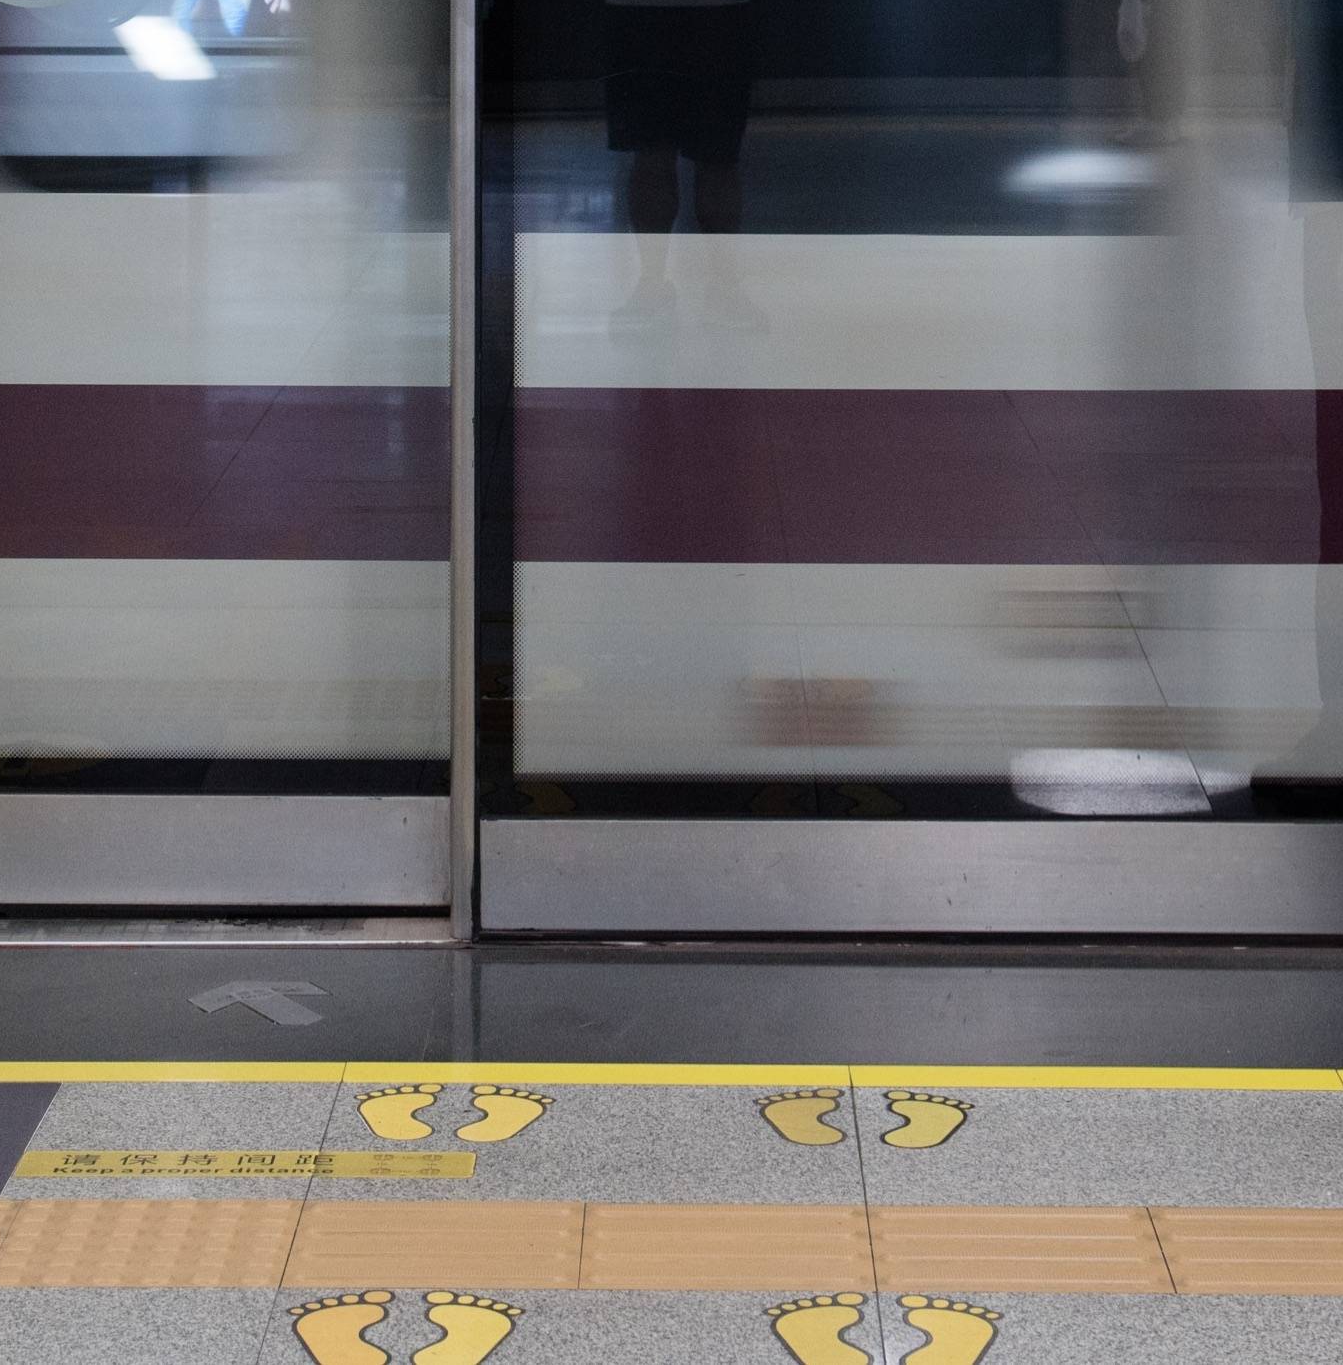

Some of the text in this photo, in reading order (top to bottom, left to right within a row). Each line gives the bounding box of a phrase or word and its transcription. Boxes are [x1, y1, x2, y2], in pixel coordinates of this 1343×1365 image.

[63, 1153, 337, 1166] 请保持间距
[52, 1166, 334, 1175] Keep a proper distance
